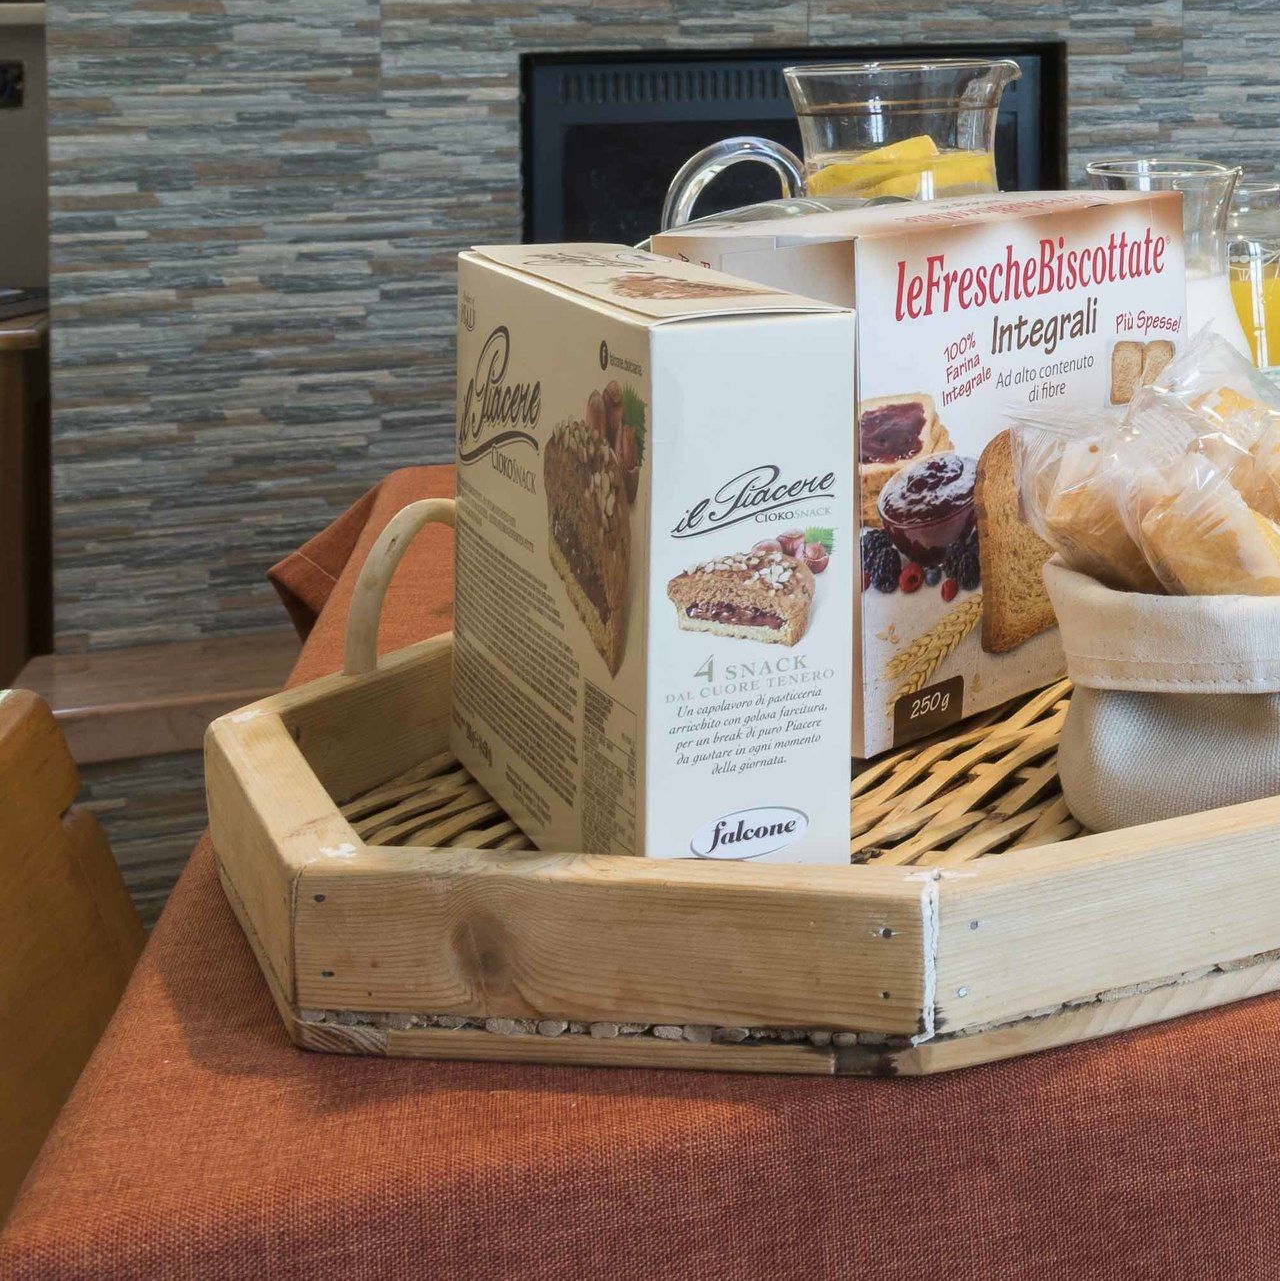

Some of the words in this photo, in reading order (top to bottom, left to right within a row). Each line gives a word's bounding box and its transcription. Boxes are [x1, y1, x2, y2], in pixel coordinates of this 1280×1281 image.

[895, 227, 1166, 322] leFrescheBiscottate
[991, 297, 1098, 355] Integrali
[1115, 311, 1134, 334] Più
[1137, 310, 1183, 335] Spesse!
[943, 331, 977, 363] 100%
[471, 325, 541, 440] Piacere
[946, 353, 981, 384] Farina
[995, 371, 1012, 390] Ad
[1014, 364, 1037, 385] alto
[1039, 354, 1095, 380] contenuto
[942, 366, 992, 407] Integrale
[1028, 385, 1040, 403] di
[1041, 380, 1067, 400] fibre
[671, 498, 710, 533] il
[708, 464, 837, 522] Piacere
[693, 654, 715, 683] 4
[725, 654, 808, 681] SNACK
[665, 691, 694, 704] DAL
[700, 680, 761, 699] CUORE
[767, 668, 835, 688] TENERO
[677, 705, 694, 718] Un
[696, 699, 753, 717] capolavoro
[755, 694, 766, 706] di
[767, 687, 823, 706] pasticceria
[669, 718, 721, 735] arricchito
[723, 716, 741, 726] con
[743, 709, 777, 727] golosa
[675, 739, 694, 753] per
[695, 737, 711, 747] un
[712, 728, 743, 745] break
[745, 727, 756, 739] di
[757, 726, 783, 739] puro
[785, 719, 823, 733] Piacere
[676, 754, 690, 766] da
[693, 749, 733, 766] gustare
[735, 745, 746, 756] in
[748, 740, 773, 755] ogni
[774, 733, 822, 749] momento
[711, 762, 737, 775] della
[738, 755, 788, 774] giornata.
[705, 819, 797, 854] falcone
